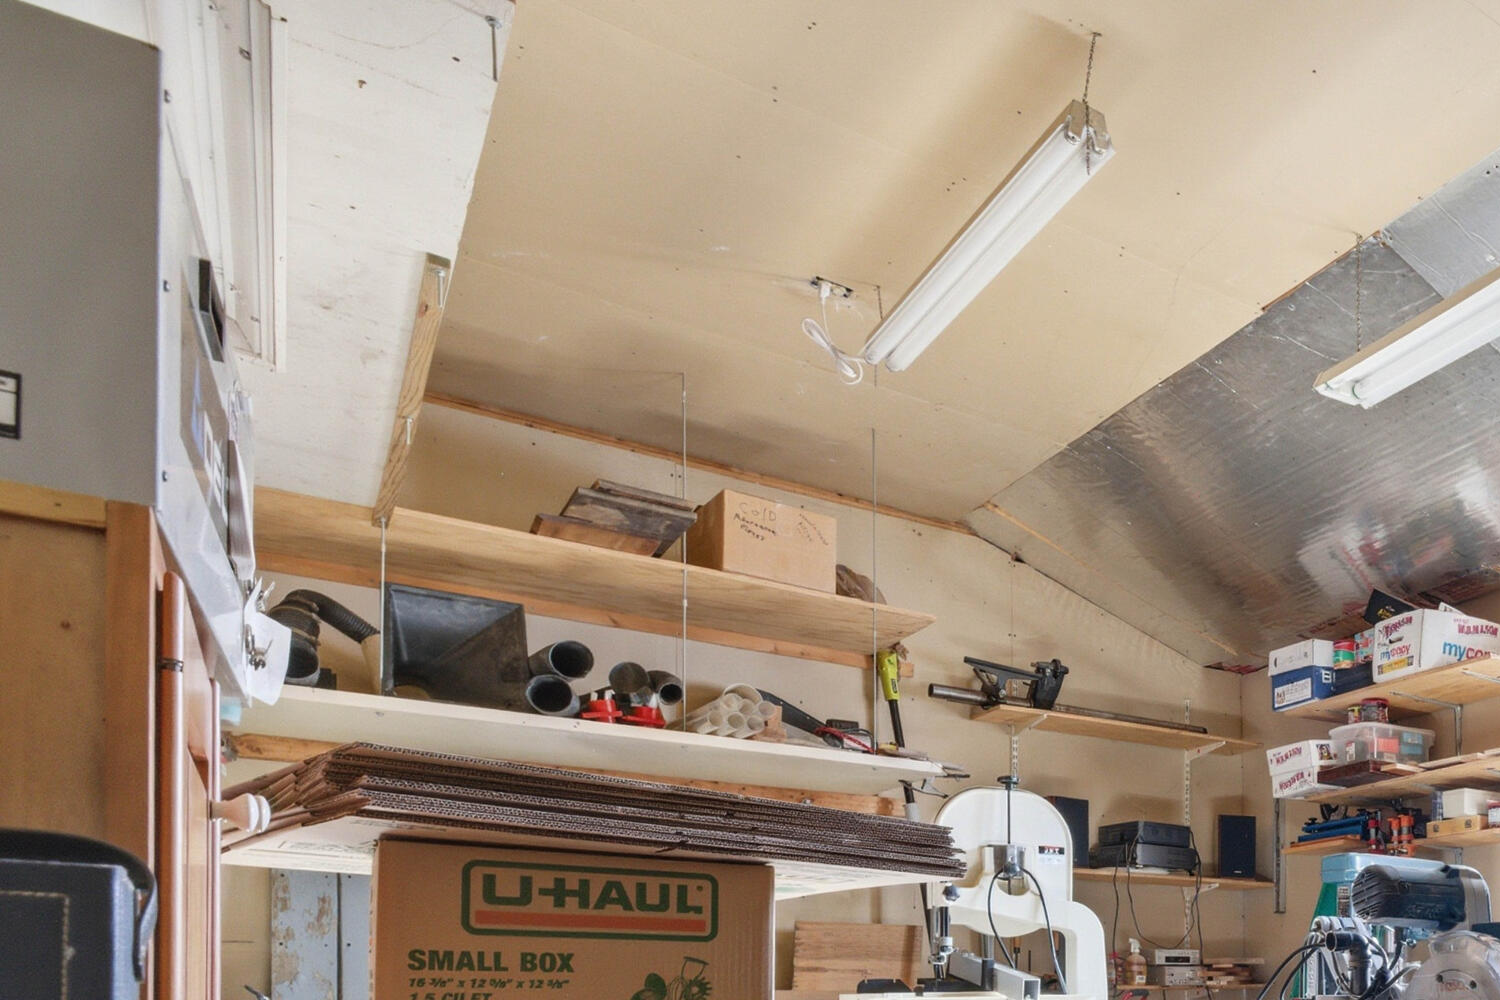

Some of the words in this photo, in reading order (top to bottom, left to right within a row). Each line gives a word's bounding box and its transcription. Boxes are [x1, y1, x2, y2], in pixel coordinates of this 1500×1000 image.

[482, 873, 704, 914] U-HAUL
[407, 948, 509, 973] SMALL
[519, 951, 575, 974] BOX
[470, 978, 487, 990] 12
[529, 979, 544, 990] 12
